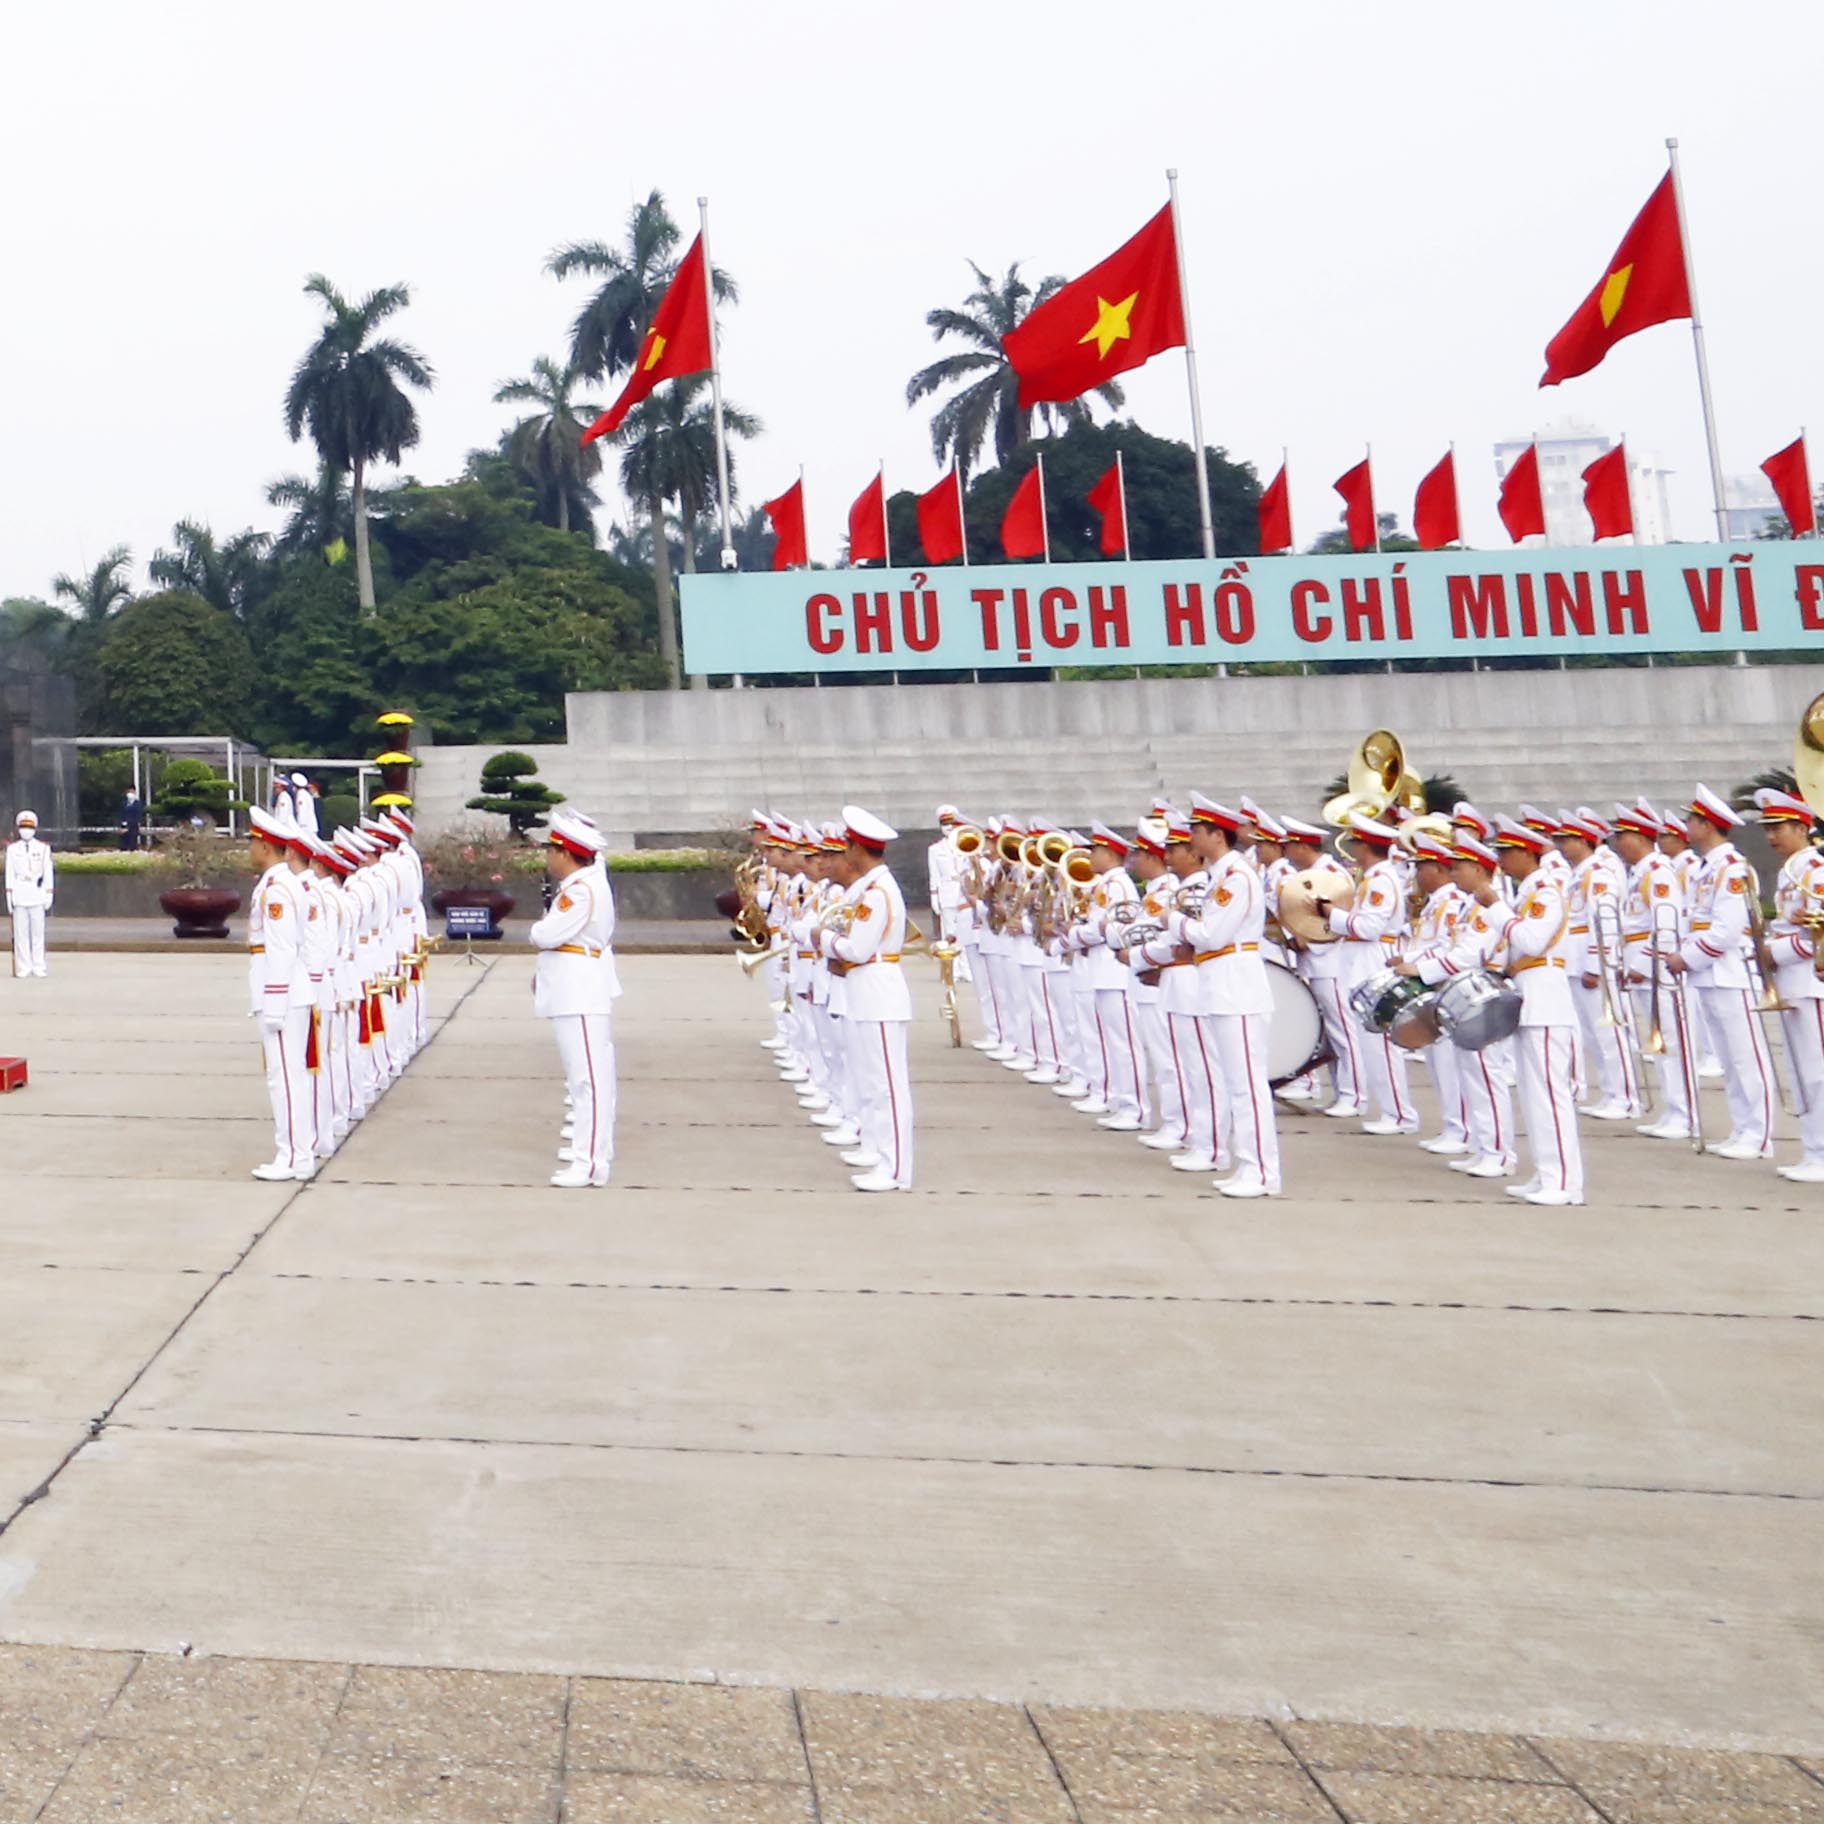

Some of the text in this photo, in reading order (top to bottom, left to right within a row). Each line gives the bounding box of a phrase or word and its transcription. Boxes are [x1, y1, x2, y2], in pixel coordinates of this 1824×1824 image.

[805, 571, 941, 655] CHỦ
[970, 584, 1131, 663] TỊCH
[1162, 560, 1256, 647] HỒ
[1290, 561, 1414, 644] CHÍ
[1445, 569, 1650, 640] MINH
[1681, 552, 1759, 634] VĨ
